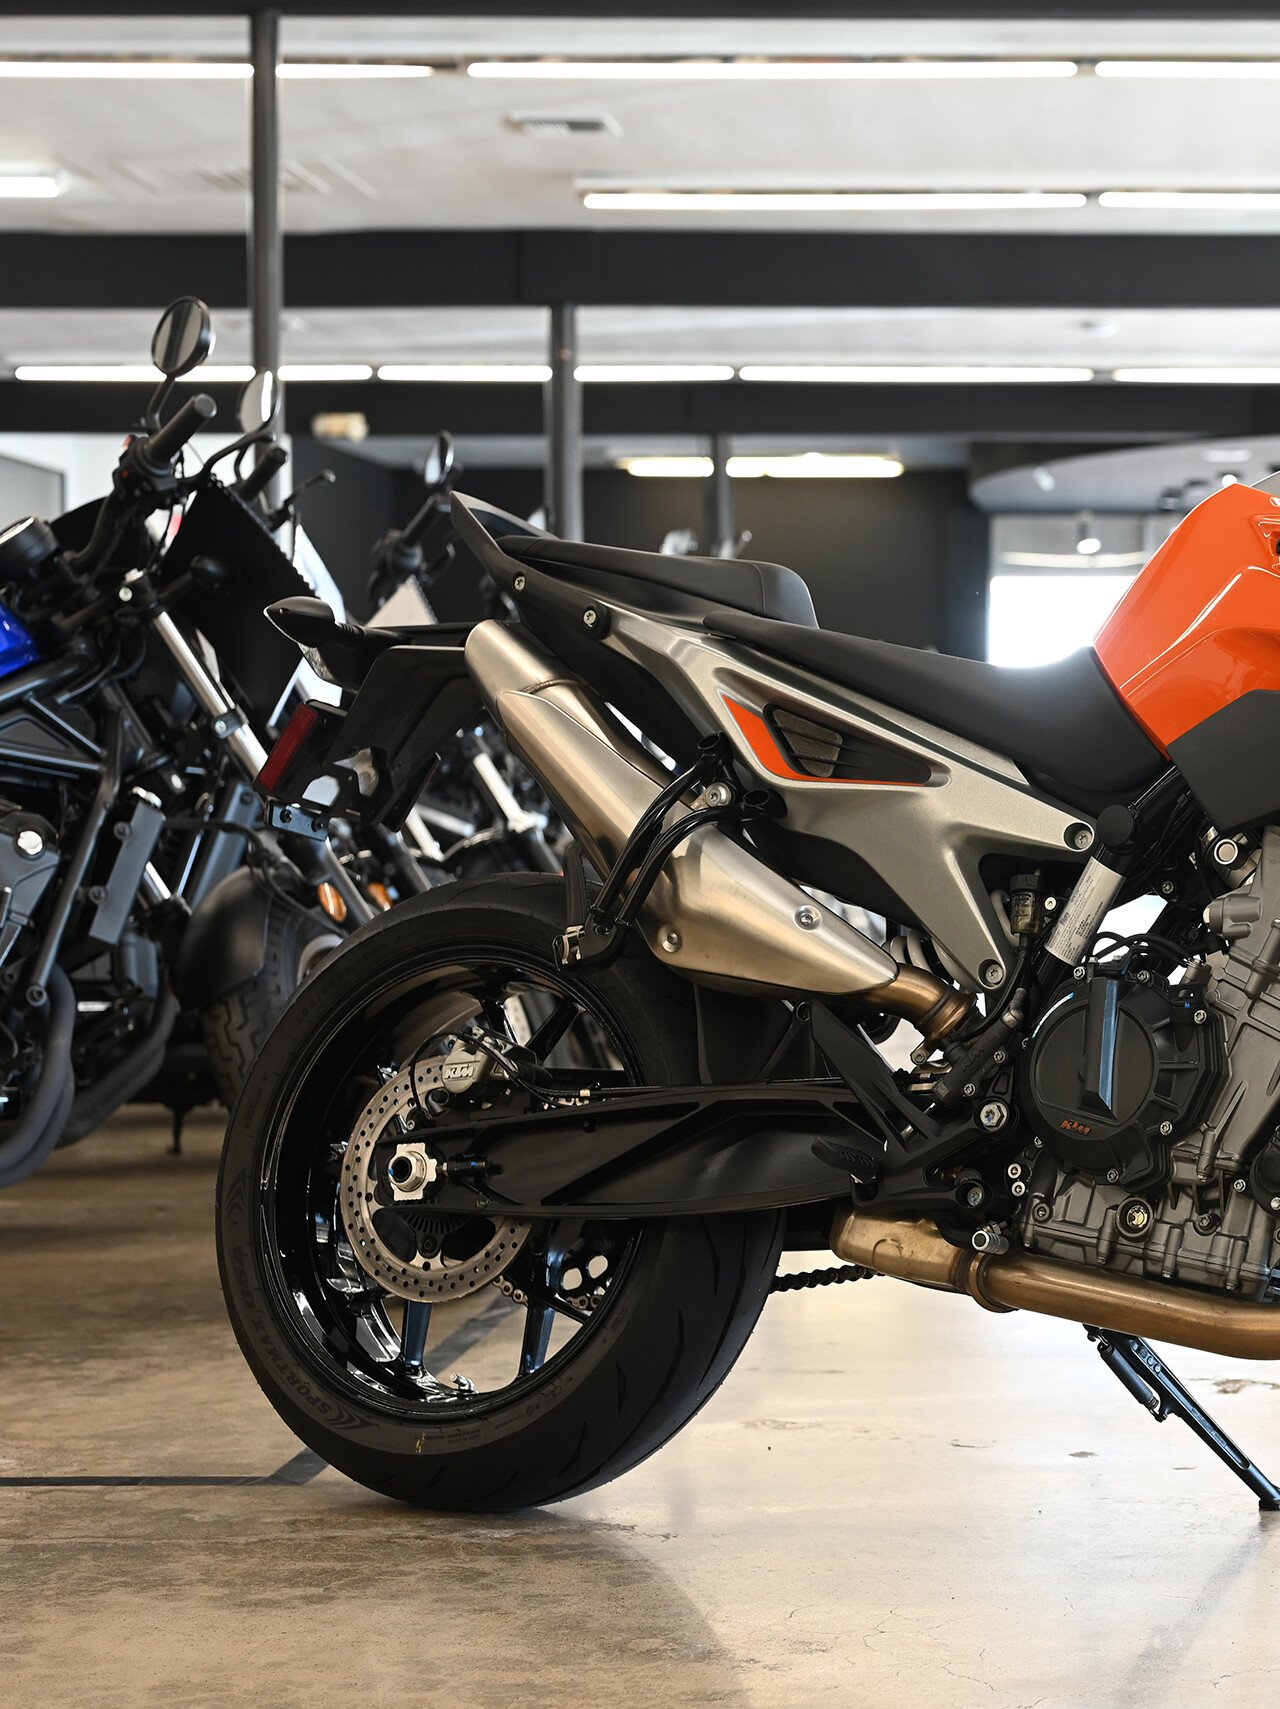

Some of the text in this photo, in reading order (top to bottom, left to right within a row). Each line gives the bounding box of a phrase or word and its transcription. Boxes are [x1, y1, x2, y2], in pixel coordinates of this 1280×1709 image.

[444, 1063, 475, 1080] KTM
[1060, 1119, 1092, 1135] KTM
[251, 1316, 332, 1414] SPORTMAX
